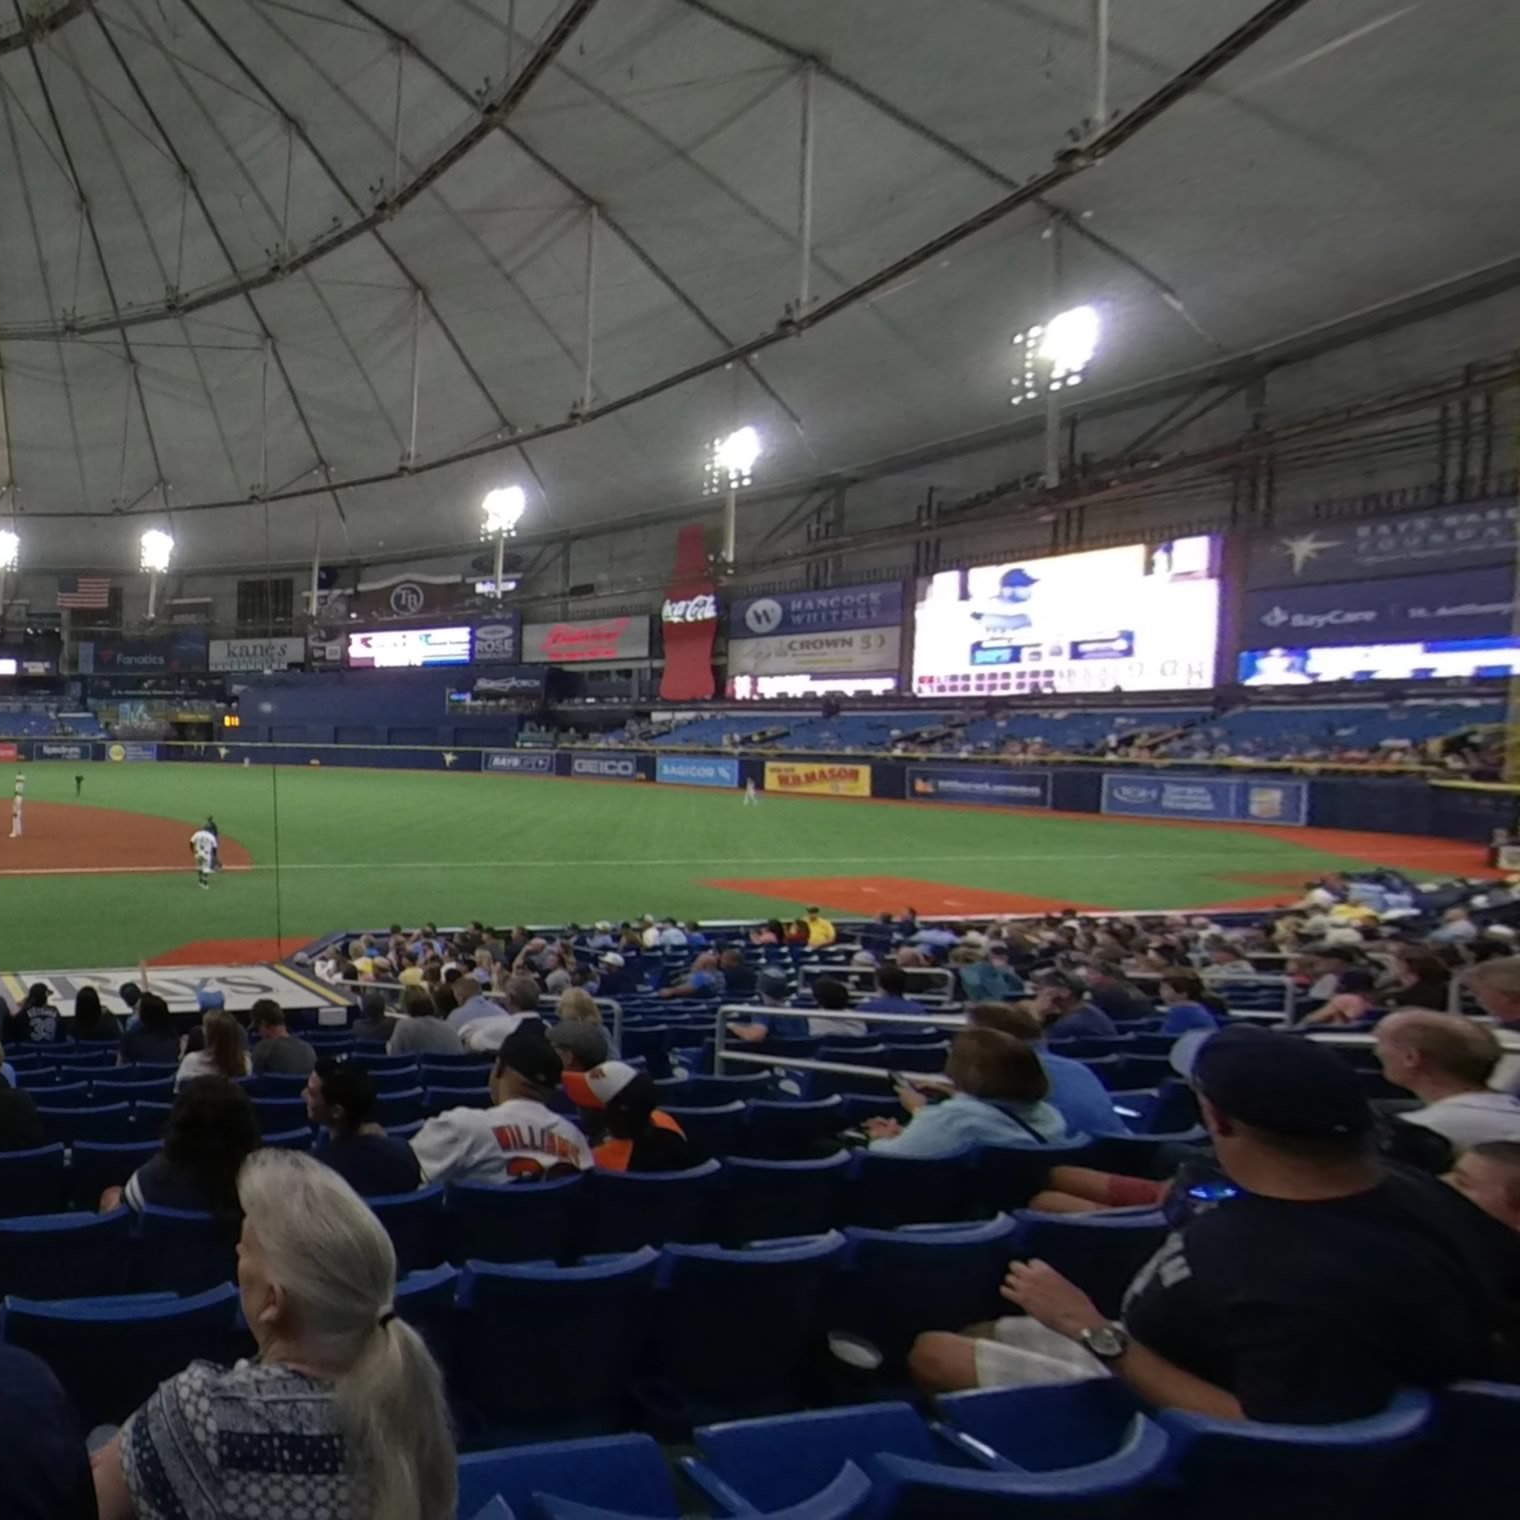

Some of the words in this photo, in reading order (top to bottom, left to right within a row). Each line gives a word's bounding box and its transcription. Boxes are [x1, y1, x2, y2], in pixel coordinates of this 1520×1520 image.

[791, 592, 880, 612] HANCOCK
[791, 606, 879, 625] WHITNEY
[226, 640, 288, 657] kane's
[476, 638, 514, 652] ROSE
[788, 636, 853, 651] CROWN
[116, 653, 165, 665] Fanatics
[574, 758, 633, 776] GEICO
